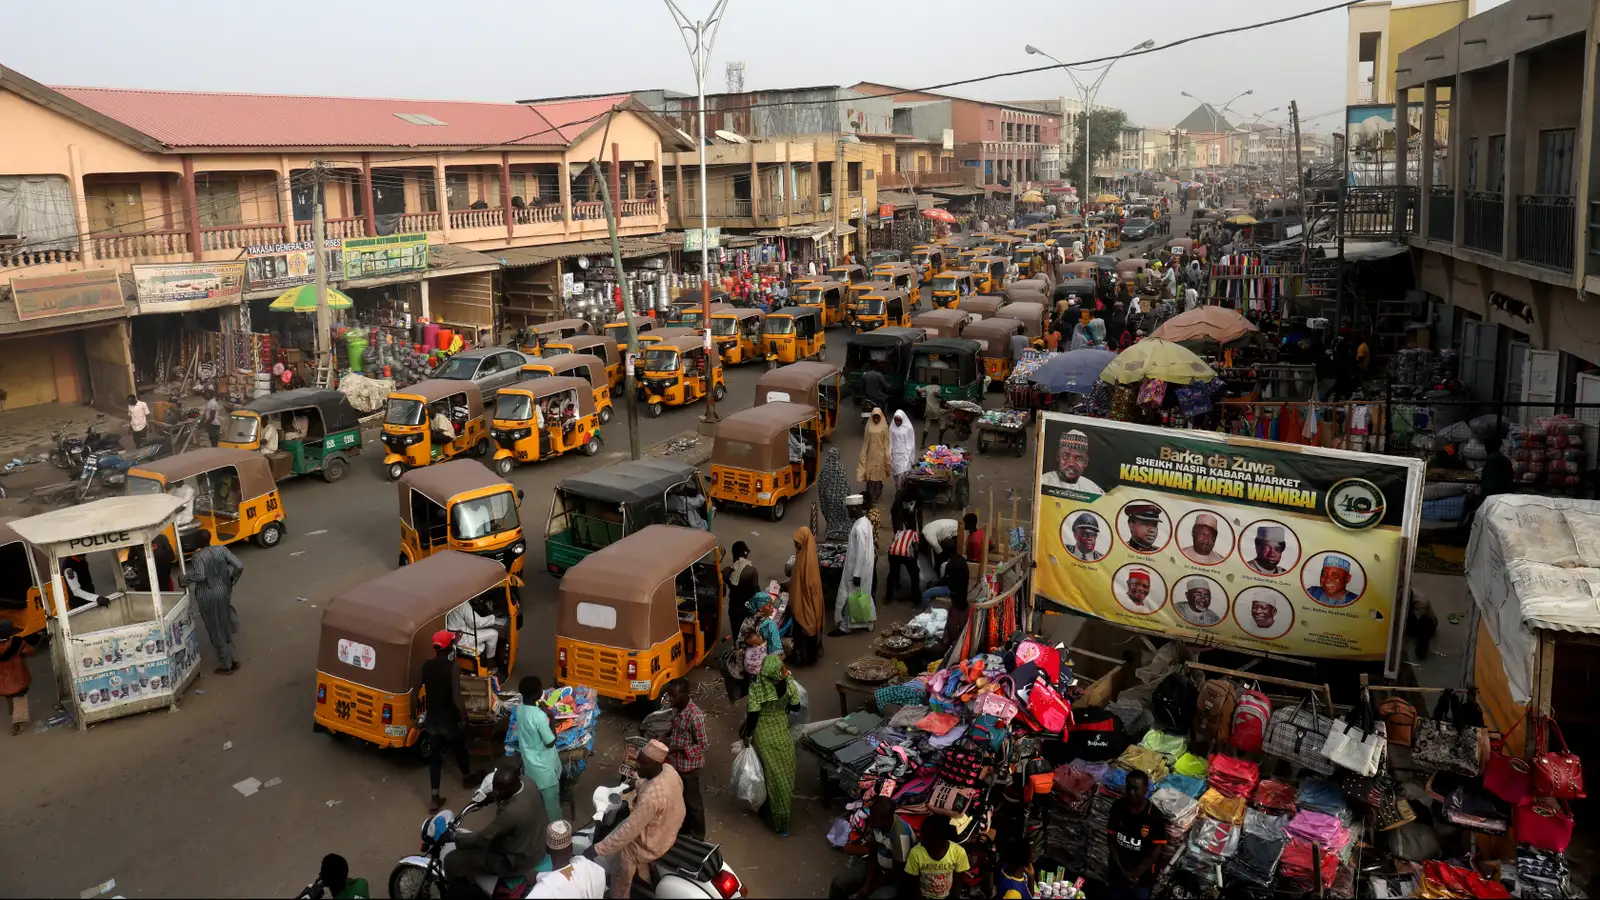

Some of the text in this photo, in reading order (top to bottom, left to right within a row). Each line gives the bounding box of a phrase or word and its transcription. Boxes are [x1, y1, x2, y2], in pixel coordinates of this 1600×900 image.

[248, 244, 274, 254] YAKASAI
[275, 242, 303, 252] GENERAL
[1160, 446, 1276, 476] Barka da Zuwa
[1136, 457, 1301, 488] SHEIKH NASIR KABARA MARKET
[1119, 463, 1193, 489] KASUWAR
[1195, 475, 1244, 499] KOFAR
[1248, 481, 1317, 510] WAMBAI
[1338, 494, 1372, 513] 40
[70, 531, 130, 549] POLICE
[1117, 832, 1141, 846] BLU
